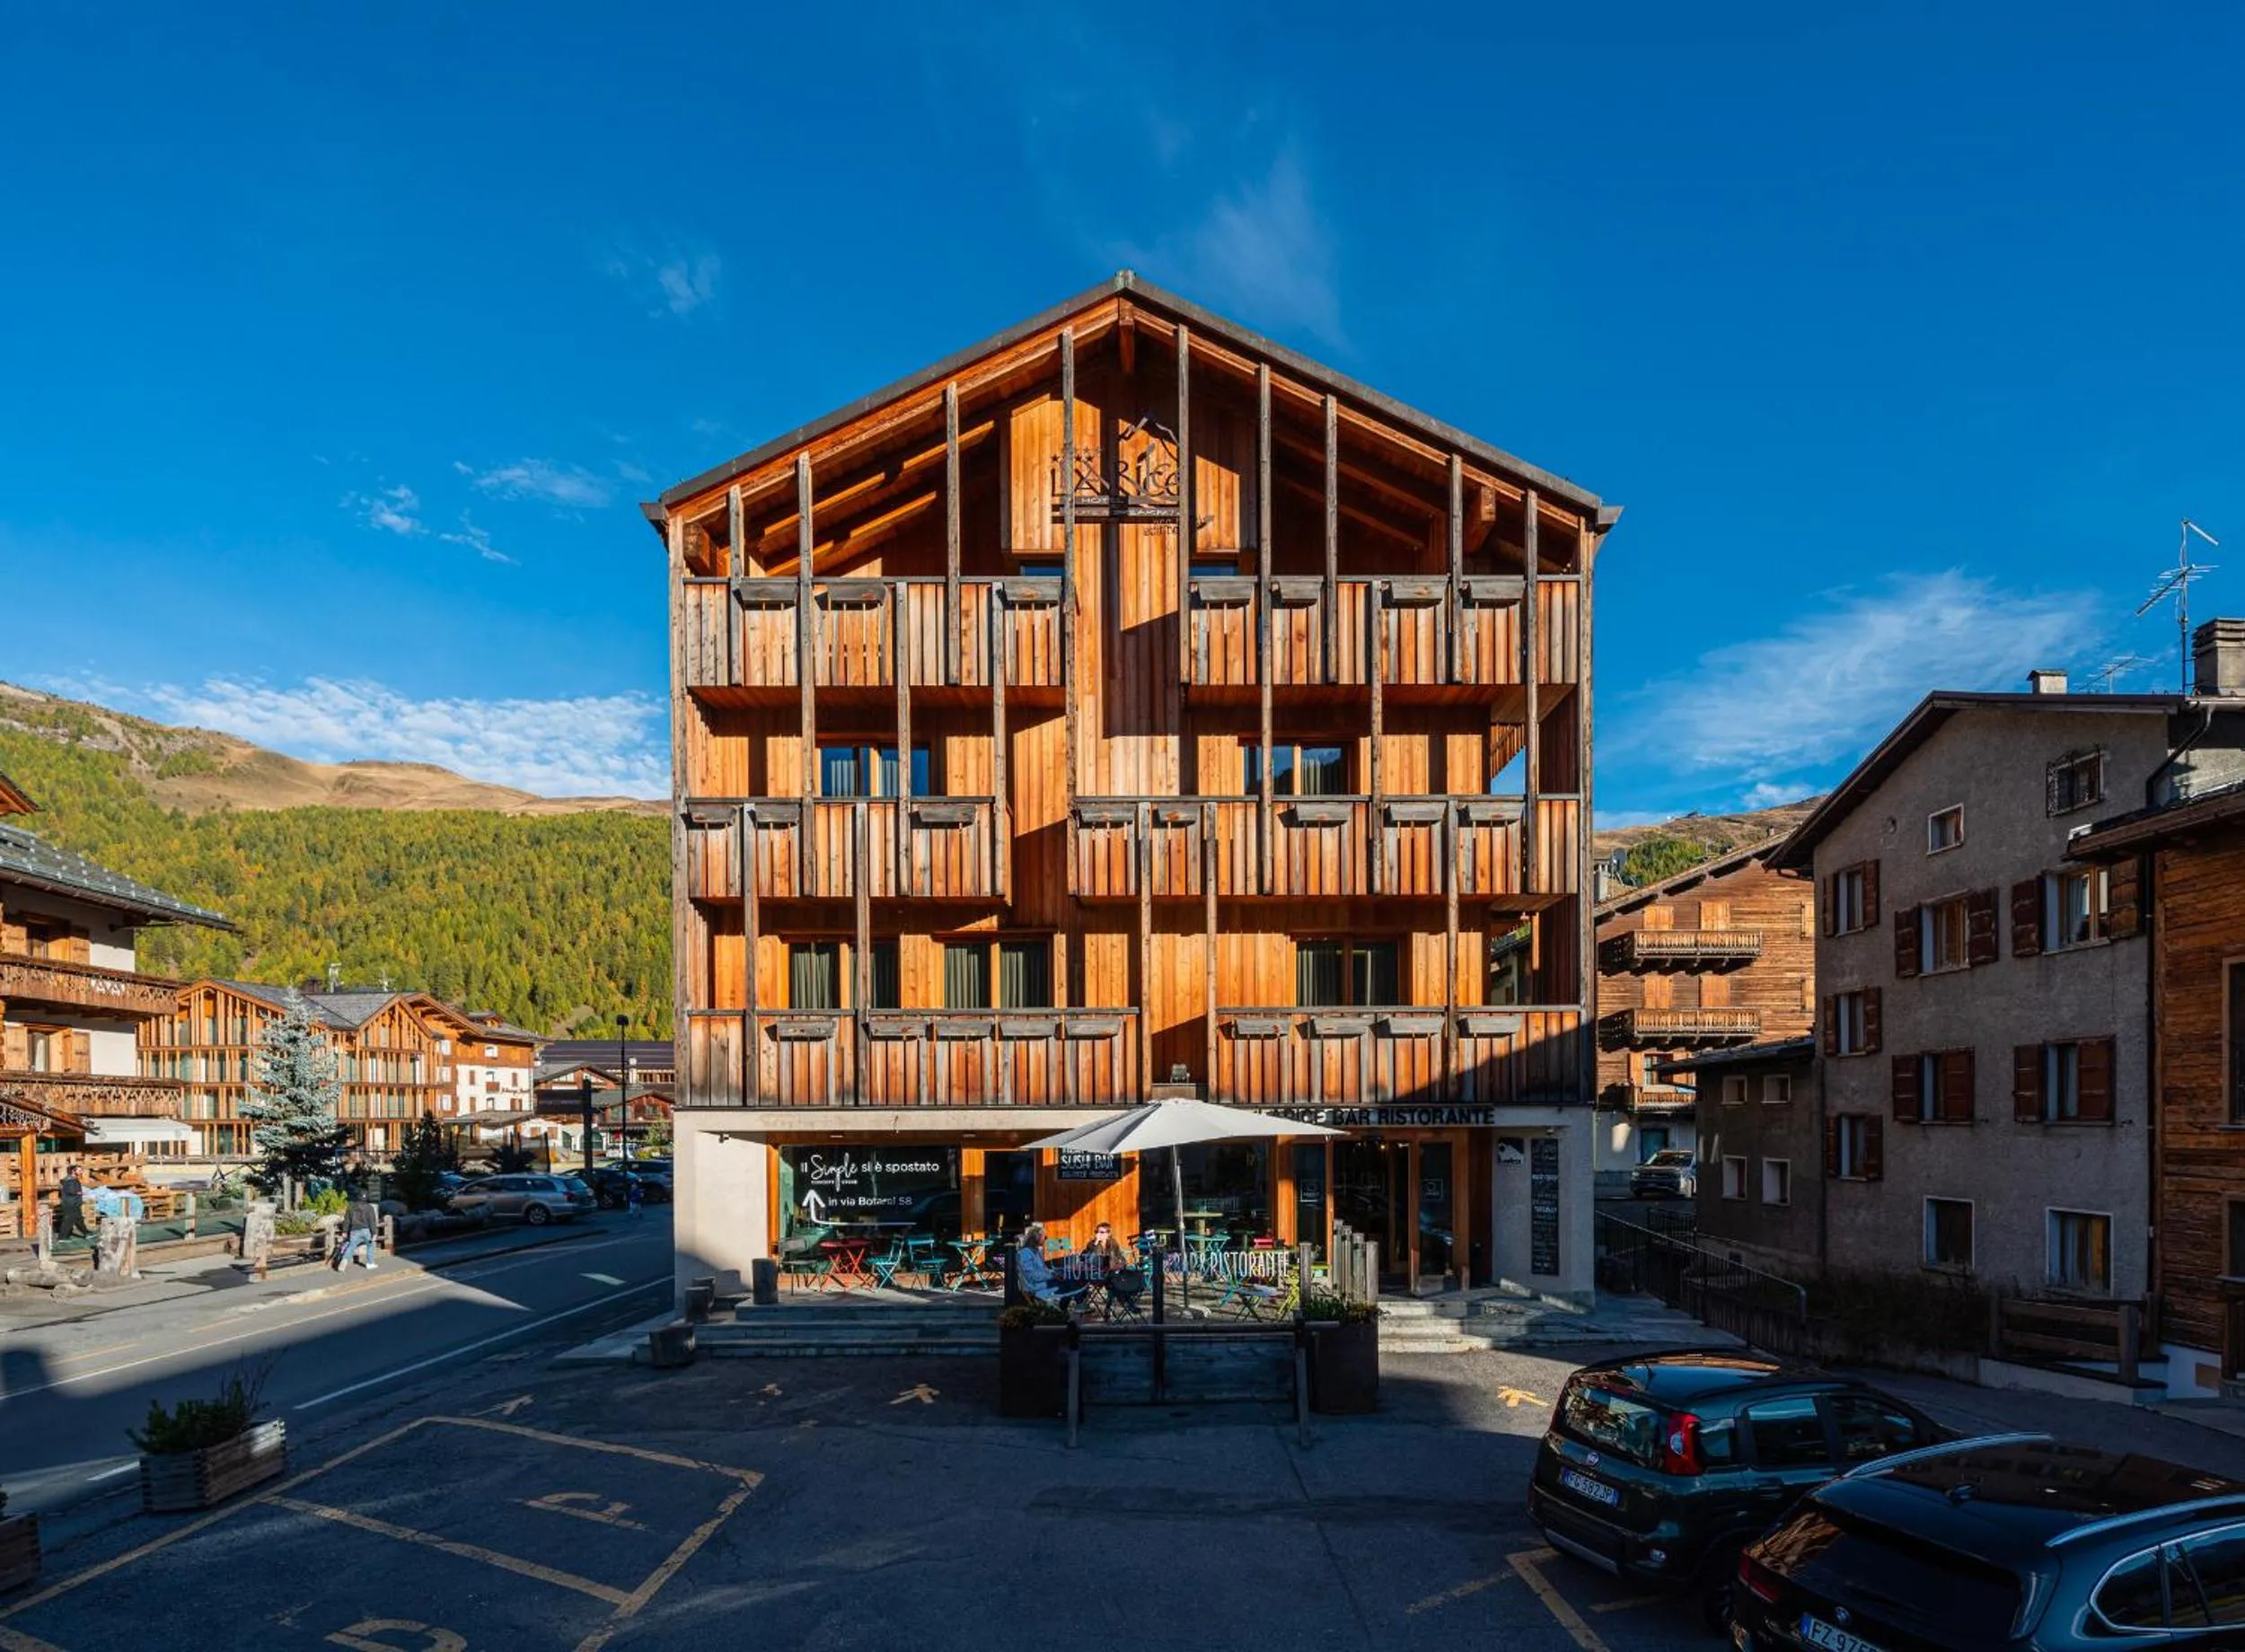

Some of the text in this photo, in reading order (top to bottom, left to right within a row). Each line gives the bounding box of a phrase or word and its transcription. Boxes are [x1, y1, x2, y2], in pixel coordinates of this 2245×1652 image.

[1333, 1108, 1370, 1126] BAR
[1378, 1108, 1495, 1126] RISTORANTE
[799, 1161, 808, 1173] Il
[810, 1152, 858, 1192] Simple
[885, 1161, 939, 1174] spostato
[827, 1196, 838, 1208] in
[841, 1196, 856, 1208] via
[899, 1196, 913, 1208] 58
